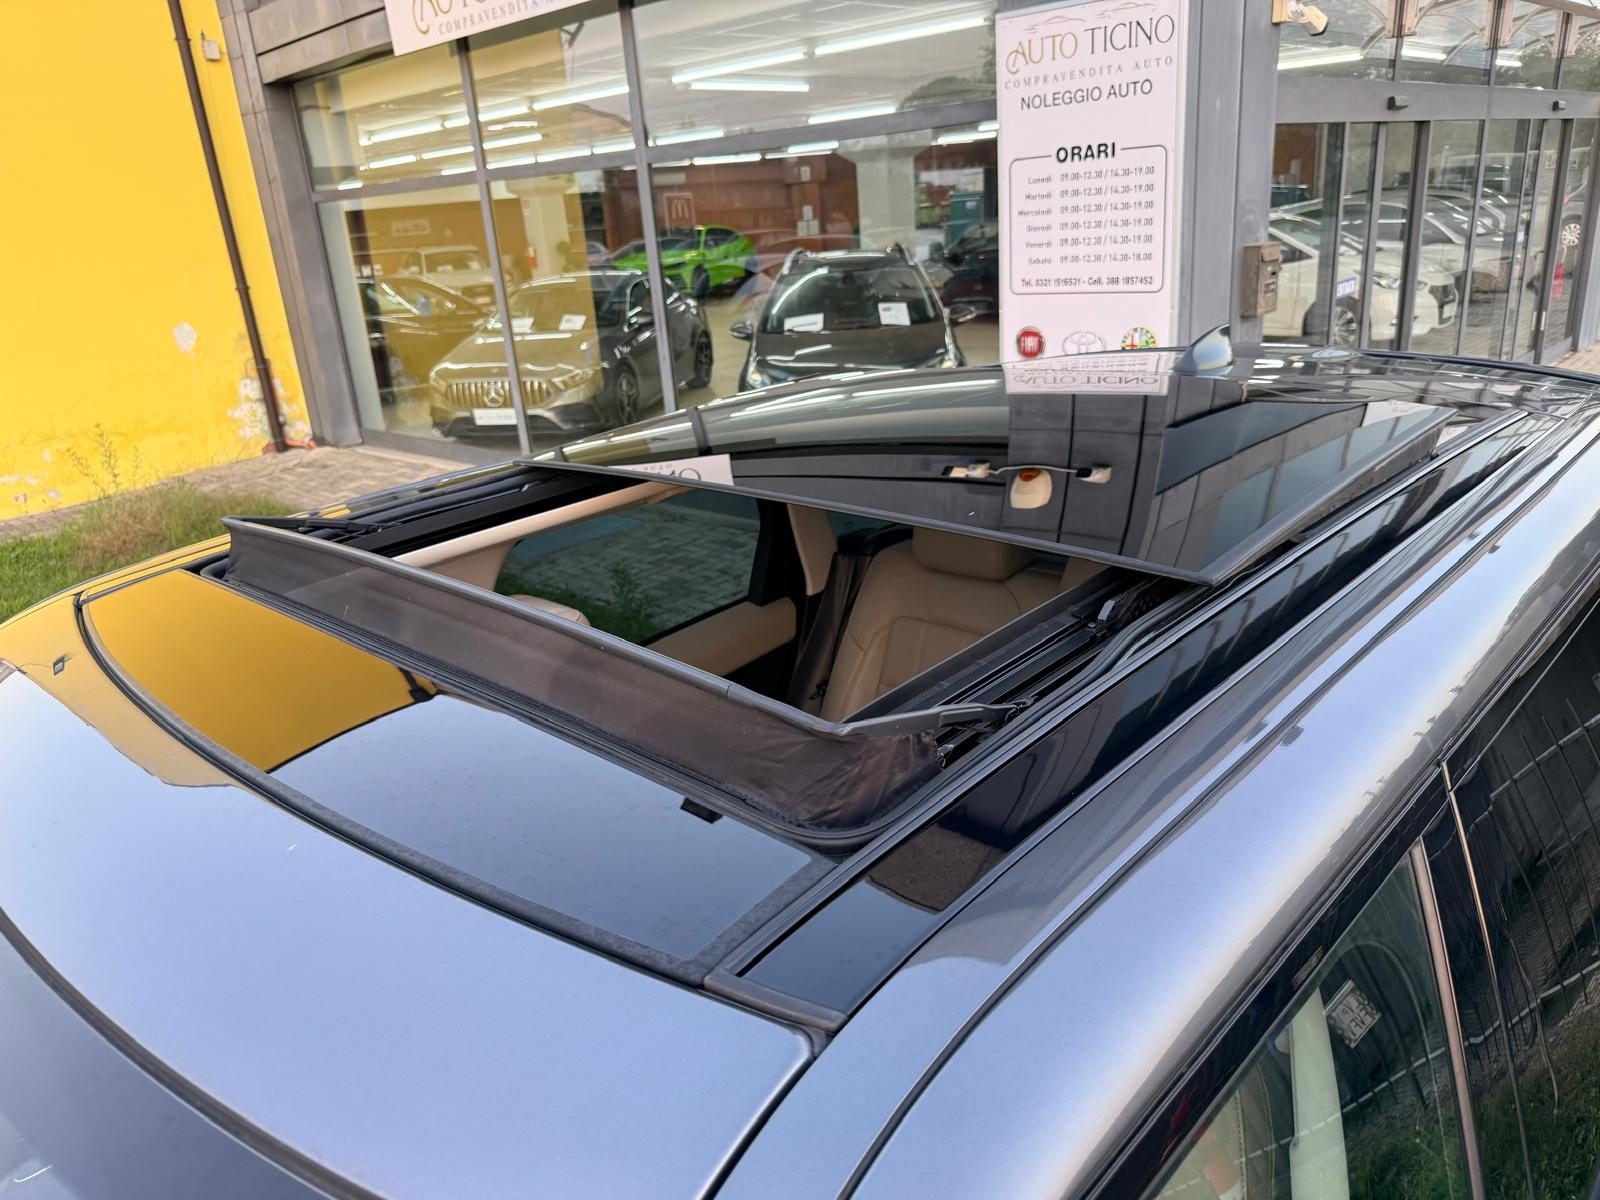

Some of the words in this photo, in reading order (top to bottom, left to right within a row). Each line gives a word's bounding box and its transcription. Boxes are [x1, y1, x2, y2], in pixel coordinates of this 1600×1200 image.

[1005, 31, 1078, 75] AUTO
[1084, 14, 1175, 55] TICINO
[1005, 64, 1124, 90] COMPRAVENDITA
[1133, 56, 1173, 71] AUTO
[1020, 86, 1102, 111] NOLEGGIO
[1107, 79, 1153, 100] AUTO
[1056, 142, 1116, 164] ORARI
[1020, 336, 1038, 352] FIAT
